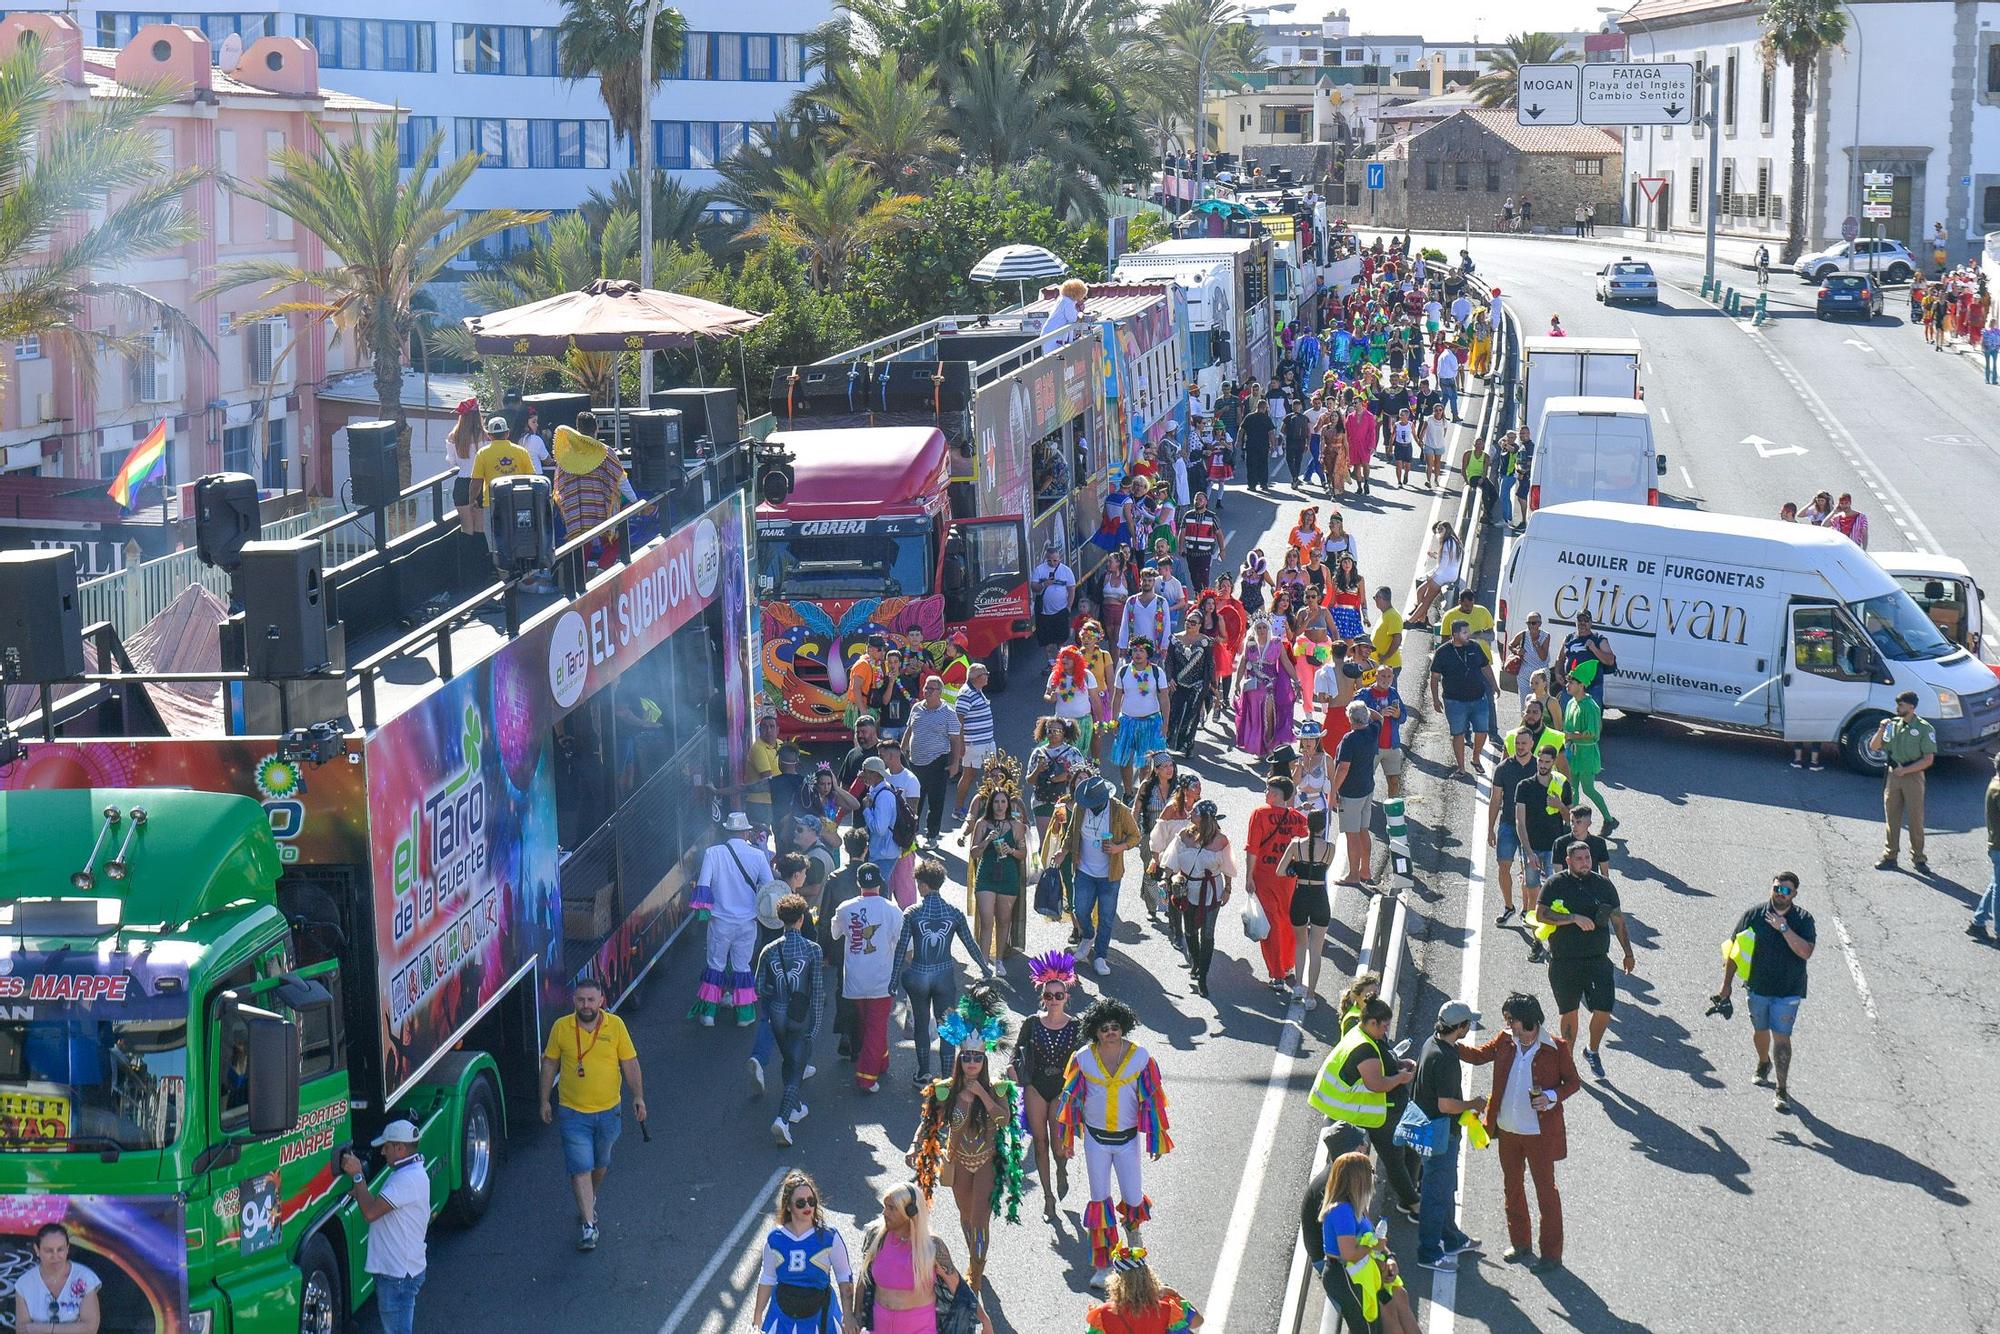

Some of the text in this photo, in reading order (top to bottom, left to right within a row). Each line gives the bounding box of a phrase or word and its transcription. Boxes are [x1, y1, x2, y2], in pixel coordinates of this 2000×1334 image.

[1523, 80, 1573, 90] MOGAN
[1589, 80, 1685, 91] Playa del Inglés
[1612, 69, 1662, 79] FATAGA
[1589, 91, 1686, 100] Cambio Sentido
[760, 528, 786, 537] TRANS.
[800, 520, 867, 536] CABRERA
[1557, 550, 1765, 589] ALQUILER DE FURGONETAS
[590, 547, 692, 667] EL SUBIDON
[1661, 597, 1749, 646] van
[556, 657, 564, 687] el
[565, 650, 584, 678] Taro
[1612, 667, 1743, 696] www.elitevan.es
[393, 810, 418, 896] el
[426, 781, 484, 866] Taro
[395, 840, 485, 940] de la suerte
[29, 974, 129, 1000] MARPE
[279, 1127, 334, 1167] MARPE
[242, 1184, 273, 1239] 94
[788, 1249, 807, 1272] B
